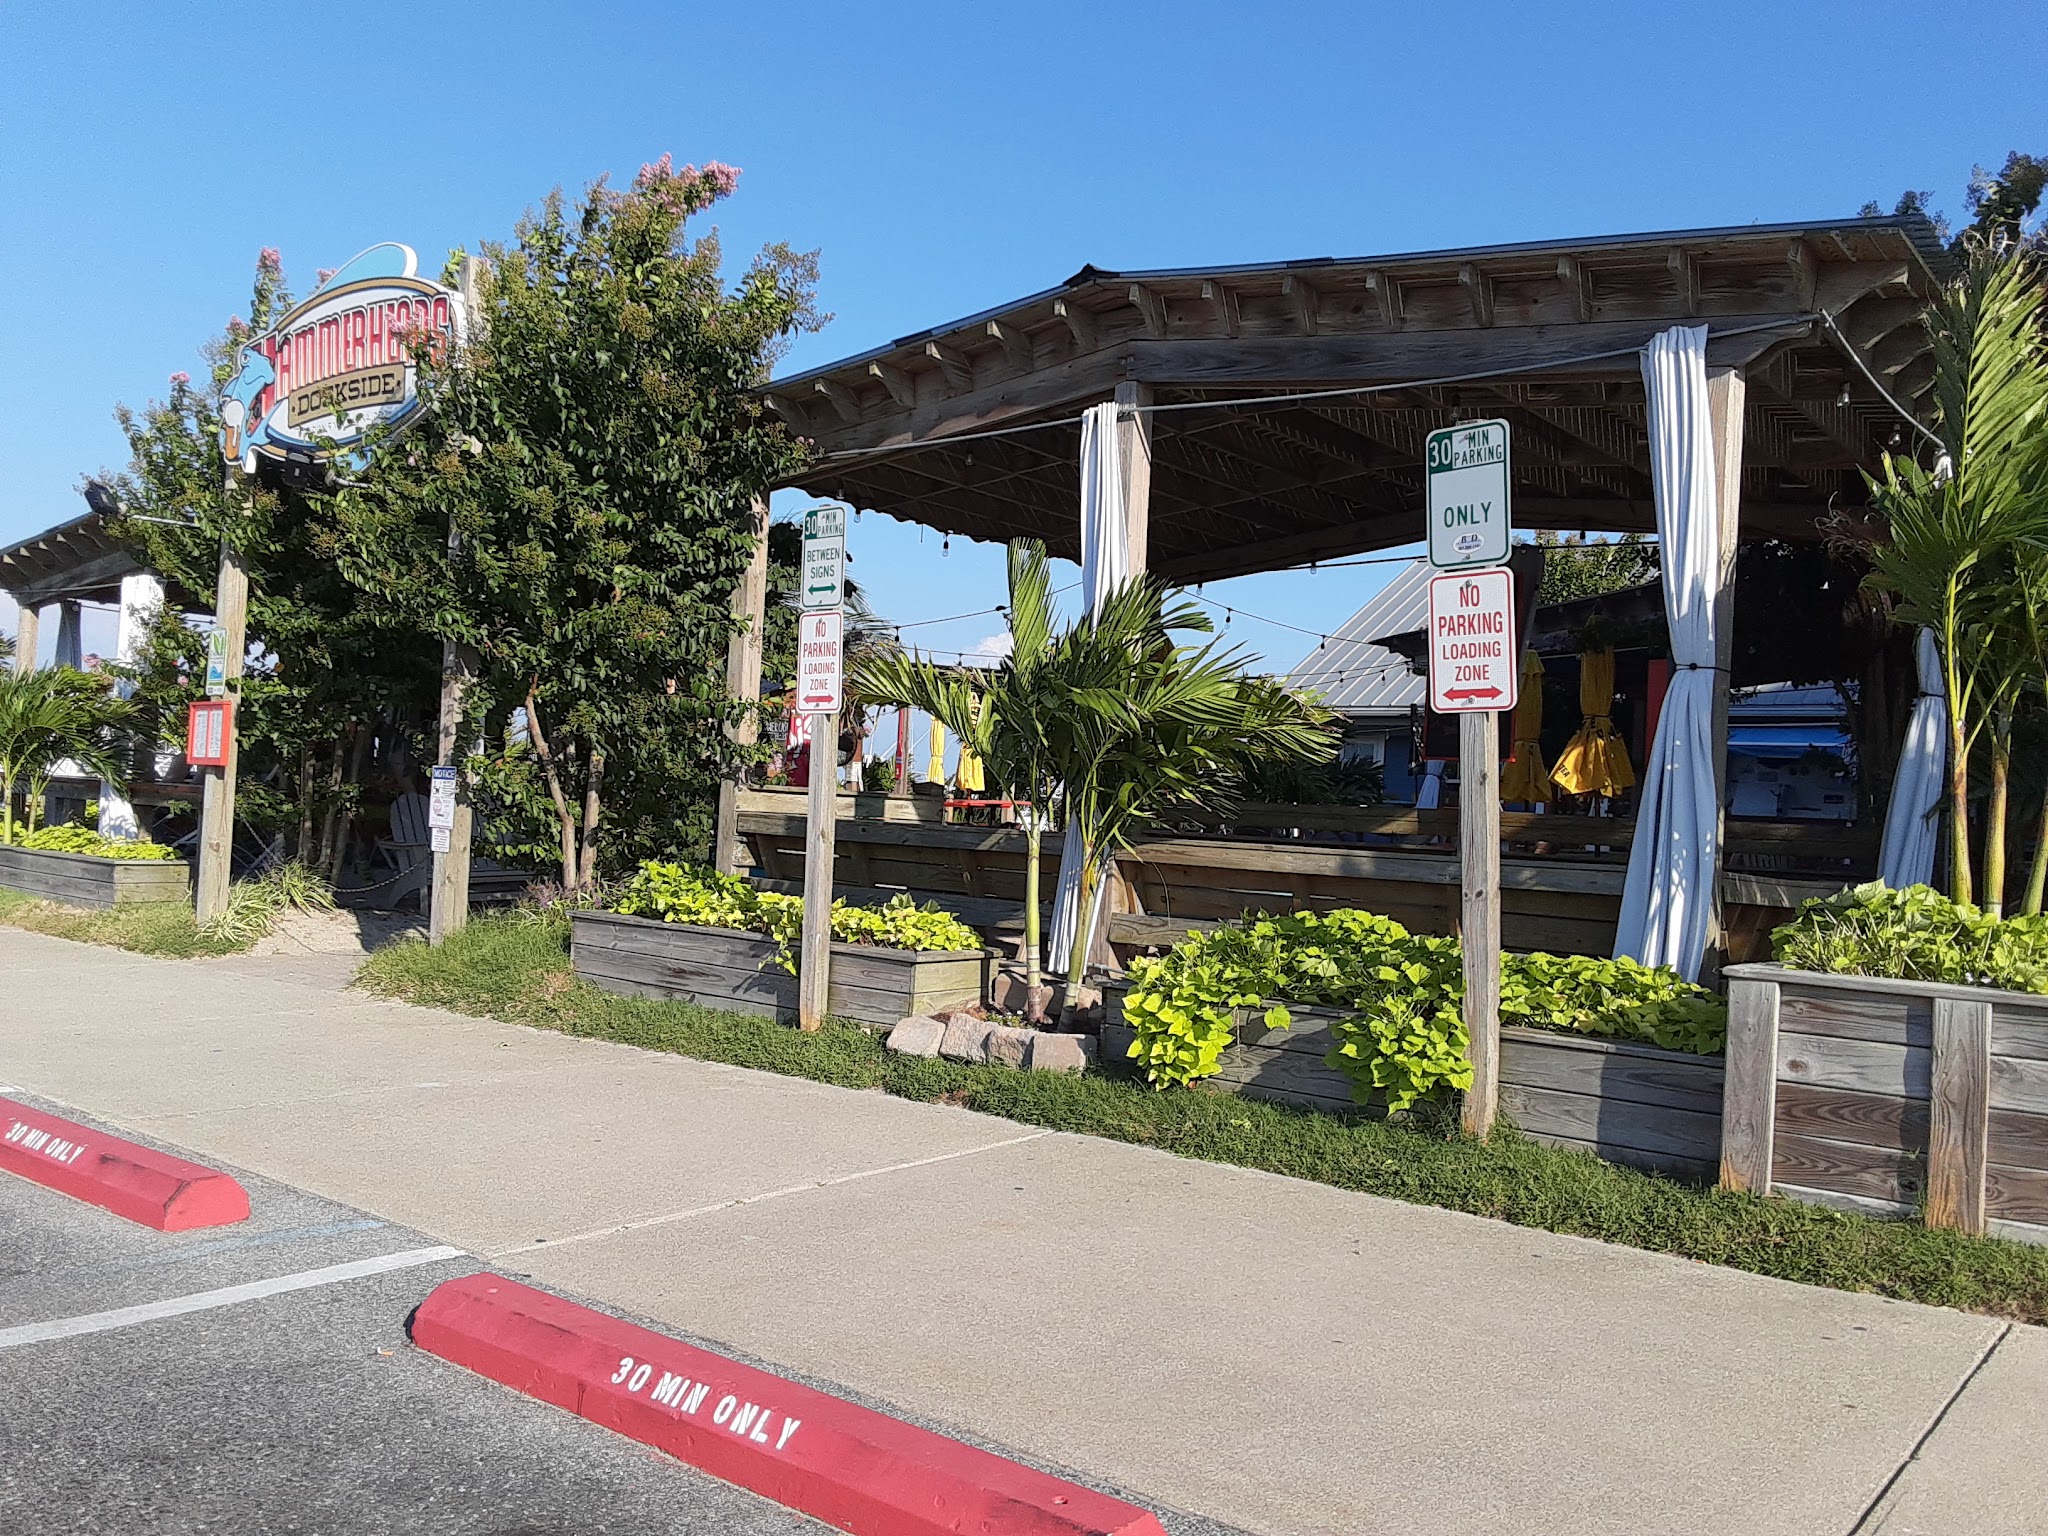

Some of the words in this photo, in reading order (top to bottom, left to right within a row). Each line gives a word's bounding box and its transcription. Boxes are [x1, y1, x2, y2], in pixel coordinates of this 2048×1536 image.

[1429, 438, 1452, 468] 30
[1468, 429, 1489, 448] MIN
[1454, 444, 1502, 467] PARKING
[805, 515, 817, 536] 30
[825, 511, 837, 524] MIN
[1444, 501, 1492, 528] ONLY
[817, 523, 843, 537] PARKING
[807, 548, 840, 562] BETWEEN
[810, 564, 835, 579] SIGNS
[1459, 585, 1480, 608] NO
[815, 621, 826, 638] NO
[1438, 611, 1503, 637] PARKING
[803, 641, 837, 658] PARKING
[1442, 641, 1501, 660] LOADING
[804, 662, 835, 675] LOADING
[1455, 664, 1490, 681] ZONE
[809, 679, 829, 691] ZONE
[433, 768, 455, 779] NOTICE
[5, 1121, 28, 1142] 30
[21, 1129, 51, 1151] MIN
[44, 1138, 85, 1165] ONLY
[611, 1357, 652, 1392] 30
[650, 1372, 710, 1415] MIN
[713, 1395, 801, 1450] ONLY
